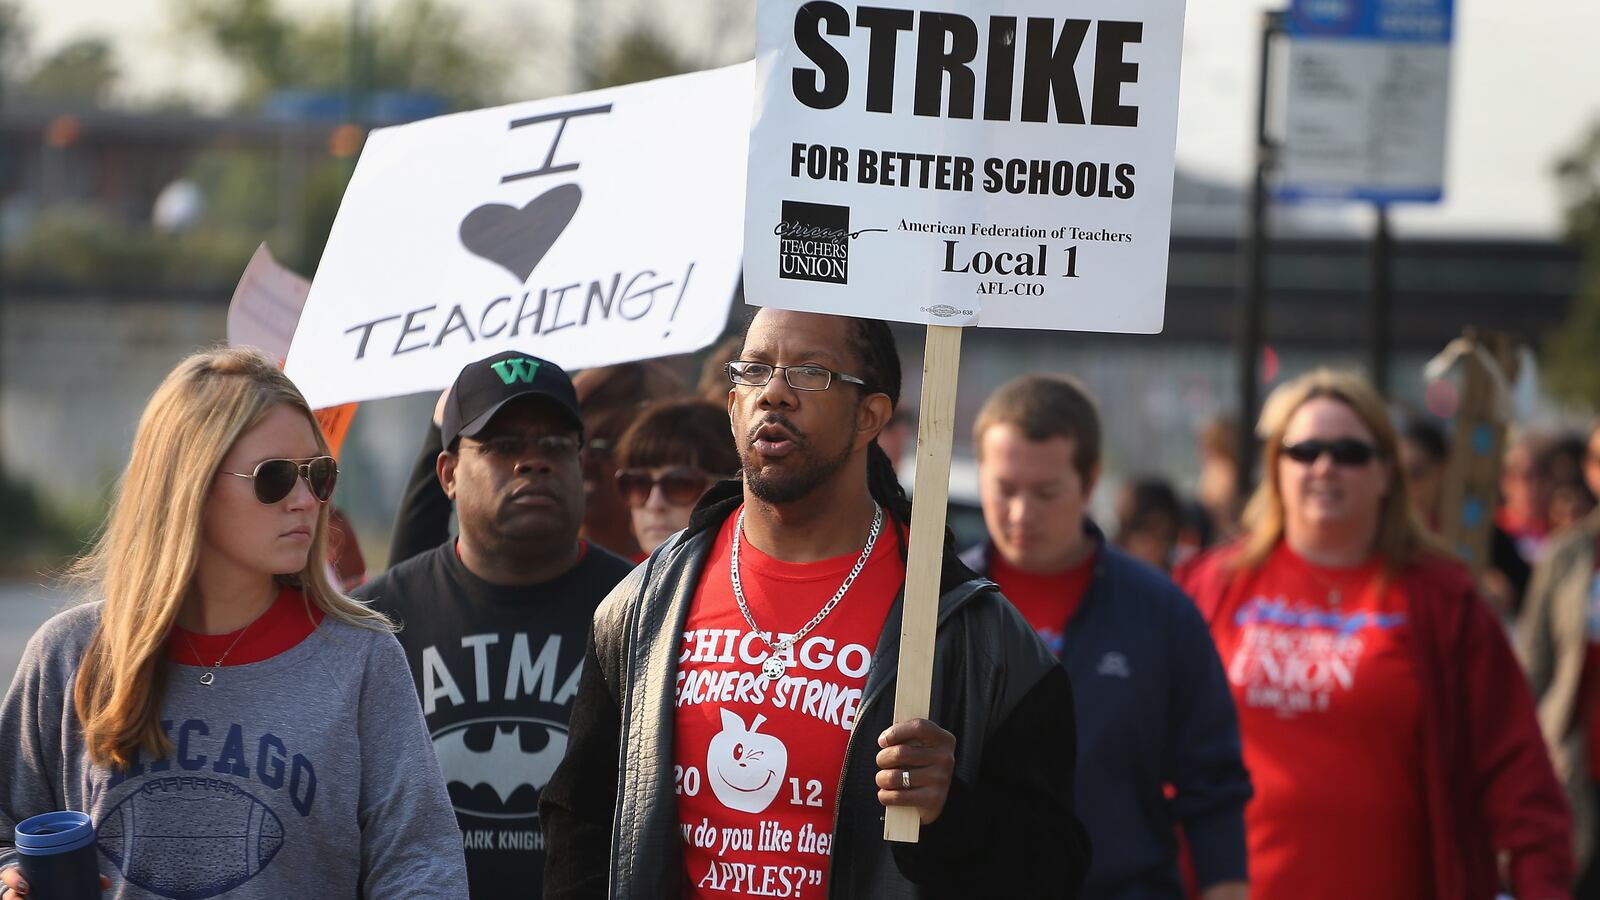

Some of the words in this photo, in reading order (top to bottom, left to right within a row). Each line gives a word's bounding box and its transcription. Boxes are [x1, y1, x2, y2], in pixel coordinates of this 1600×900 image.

[792, 0, 1143, 127] STRIKE
[500, 103, 613, 184] I
[790, 142, 848, 181] FOR
[857, 148, 974, 192] BETTER
[983, 157, 1136, 199] SCHOOLS
[774, 220, 888, 244] Chicago
[781, 239, 847, 259] TEACHERS
[897, 218, 966, 235] American
[971, 223, 1046, 239] Federation
[1051, 226, 1066, 239] of
[1069, 226, 1132, 243] Teachers
[781, 254, 847, 279] UNION
[941, 240, 1047, 276] Local
[1062, 245, 1080, 278] 1
[976, 282, 1044, 297] AFL-CIO
[344, 262, 695, 361] TEACHING!
[490, 358, 540, 384] W
[423, 633, 585, 716] ATMA
[675, 669, 770, 708] EACHERS
[673, 764, 700, 796] 20
[789, 777, 823, 807] 12
[464, 830, 494, 849] ARK
[498, 830, 545, 850] KNIGH
[694, 818, 716, 848] do
[718, 827, 753, 856] you
[758, 821, 792, 853] like
